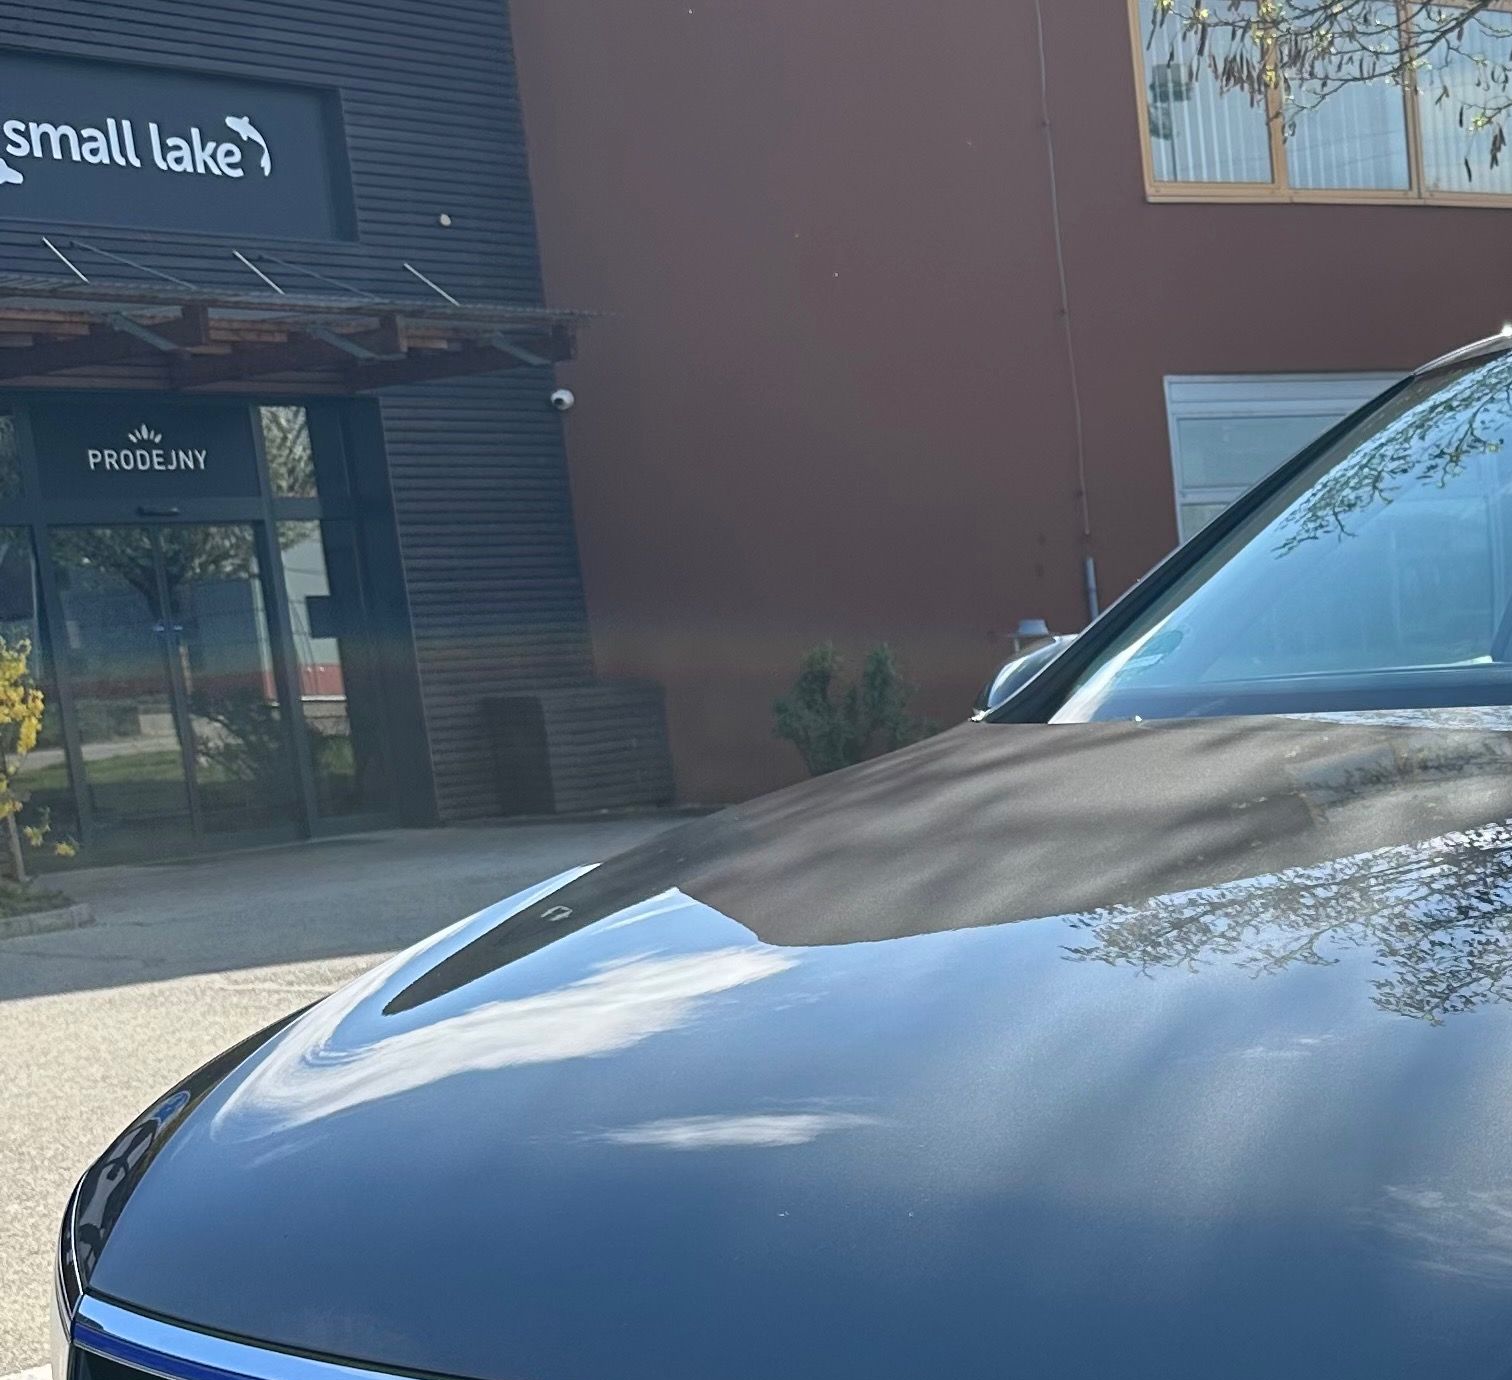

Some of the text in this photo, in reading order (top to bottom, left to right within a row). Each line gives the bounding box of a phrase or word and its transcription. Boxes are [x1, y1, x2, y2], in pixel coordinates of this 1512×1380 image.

[3, 117, 244, 178] small lake
[88, 448, 207, 471] PRODEJNY
